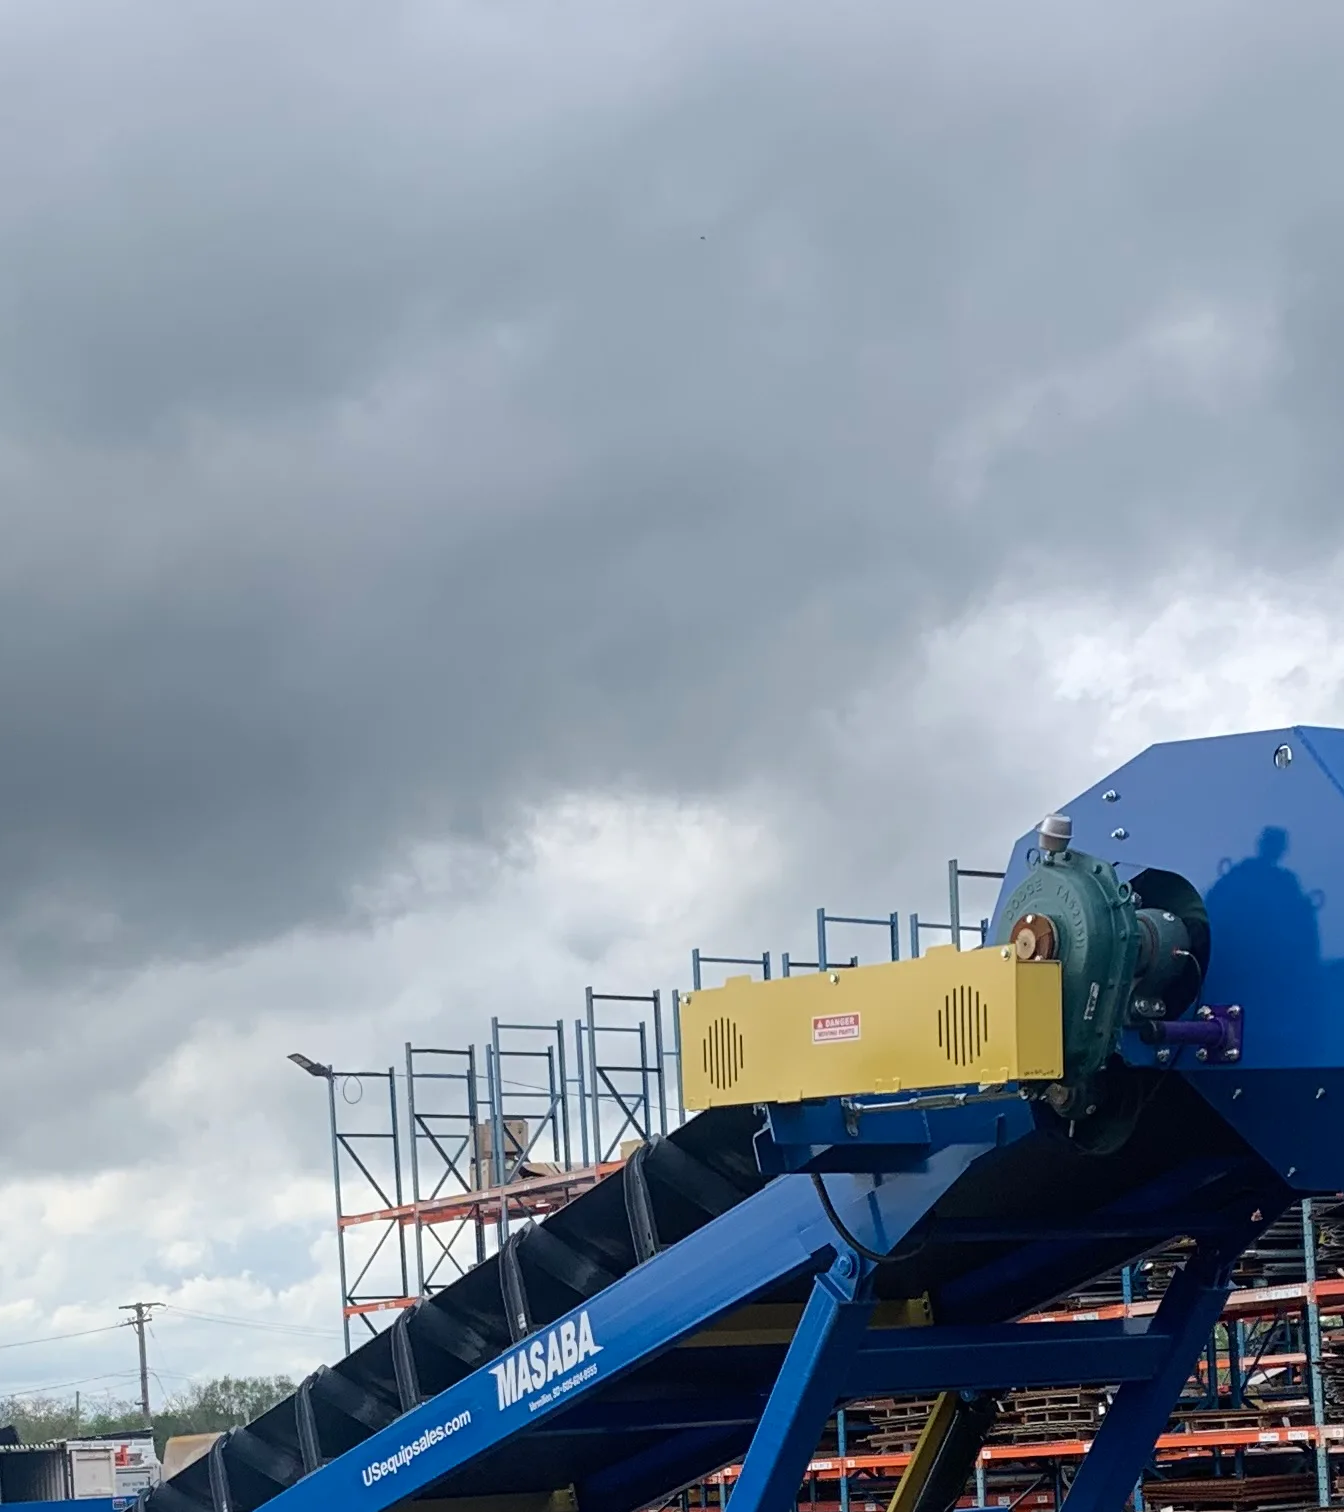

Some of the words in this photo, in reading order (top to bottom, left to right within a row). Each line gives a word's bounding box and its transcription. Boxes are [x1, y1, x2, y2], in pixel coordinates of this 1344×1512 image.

[825, 1016, 855, 1028] DANGER
[488, 1310, 604, 1412] MASABA
[361, 1409, 472, 1487] USequipsales.com
